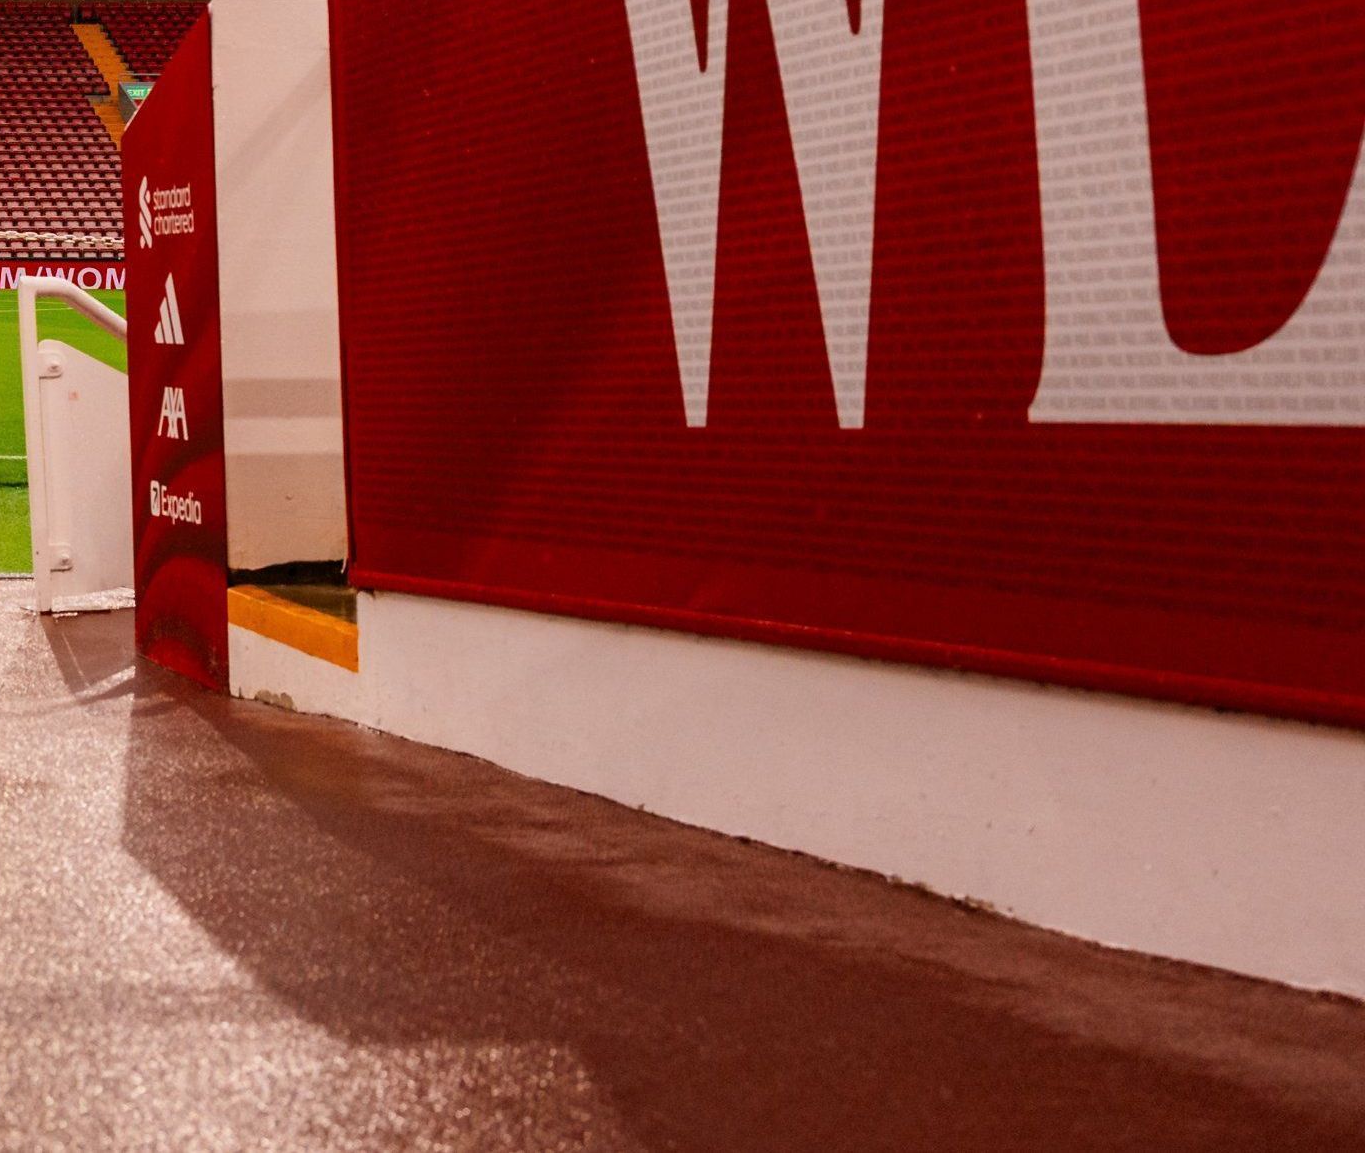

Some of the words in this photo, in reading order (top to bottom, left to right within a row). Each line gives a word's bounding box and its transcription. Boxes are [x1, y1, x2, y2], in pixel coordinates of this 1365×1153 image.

[153, 183, 191, 210] standard
[154, 209, 194, 235] chartered
[156, 386, 190, 442] AXA
[161, 484, 202, 525] Expedia
